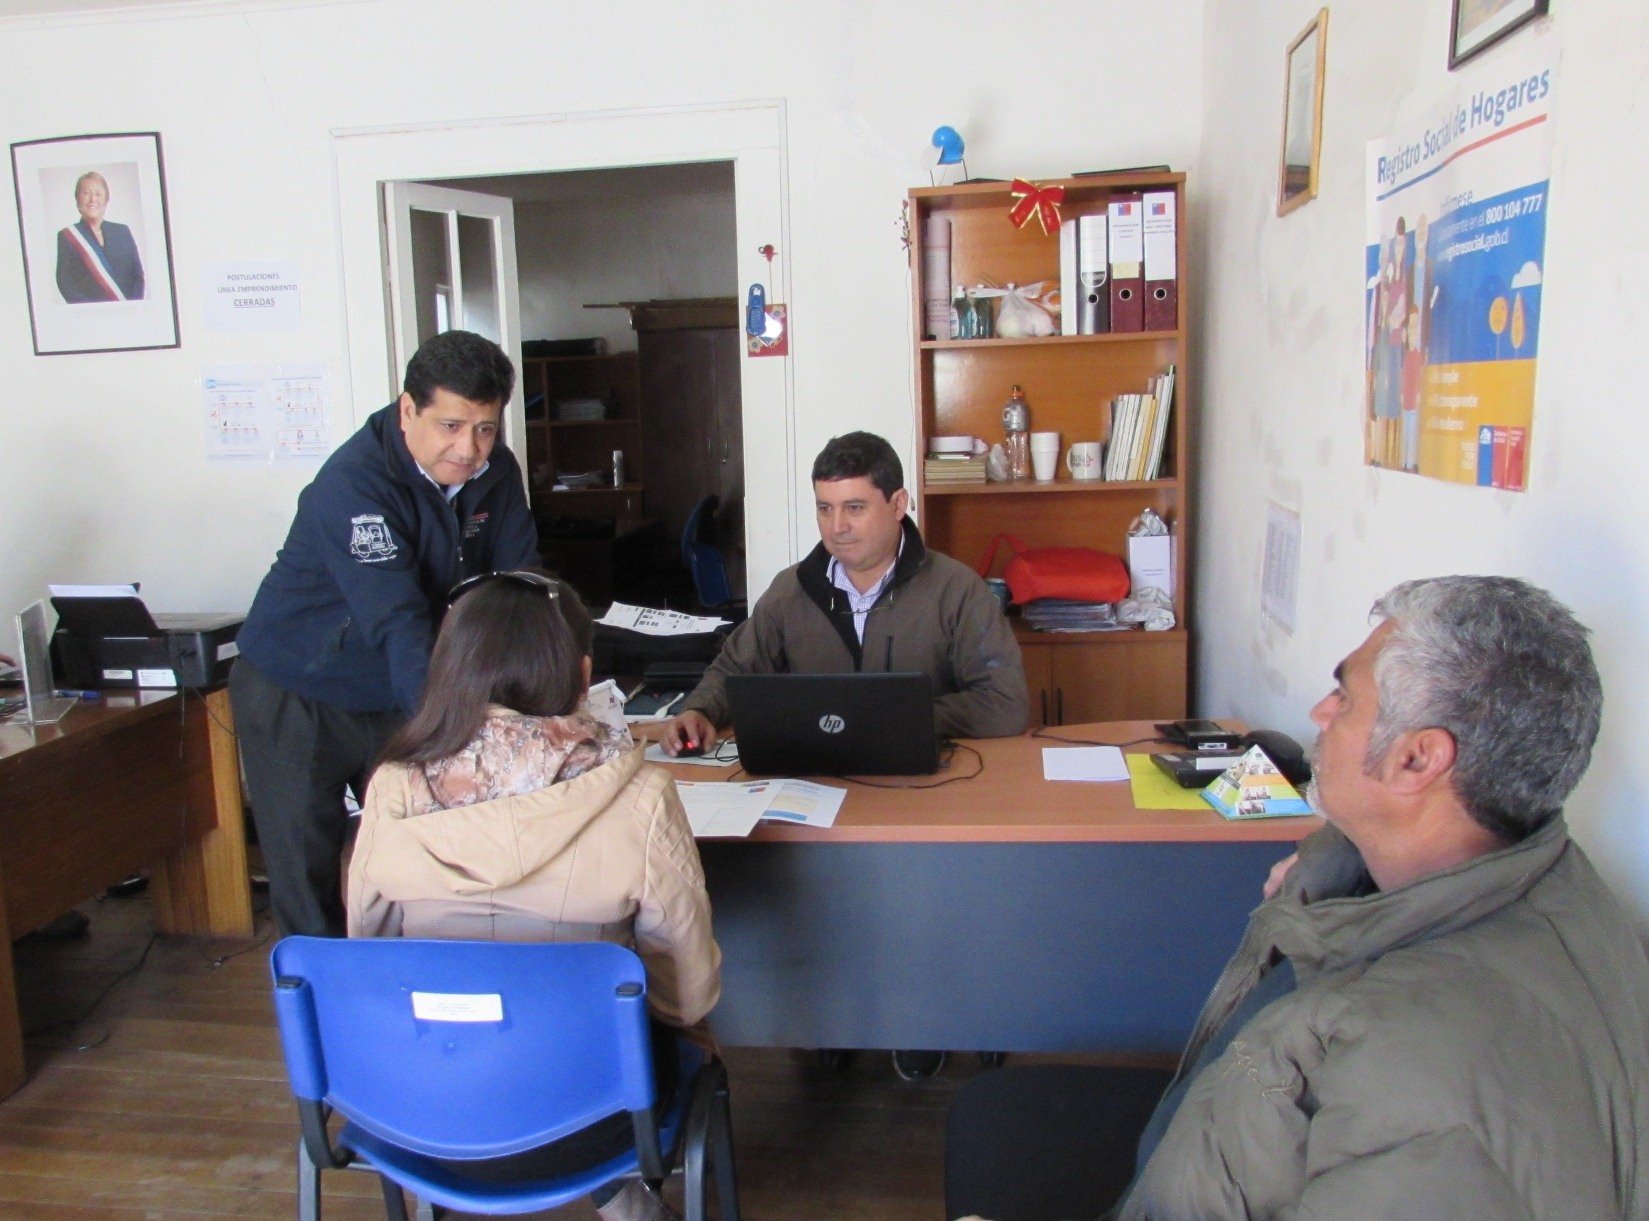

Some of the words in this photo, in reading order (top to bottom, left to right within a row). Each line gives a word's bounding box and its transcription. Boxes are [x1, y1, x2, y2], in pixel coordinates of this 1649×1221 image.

[1377, 143, 1420, 184] Registro
[1423, 112, 1452, 160] Social
[1470, 69, 1549, 129] Hogares
[1485, 205, 1503, 225] 800
[1504, 200, 1520, 220] 104
[1522, 193, 1542, 215] 777
[227, 273, 280, 281] POSTULACIONES
[237, 284, 298, 293] EMPRENDIMIENTO
[233, 298, 276, 307] CERRADAS
[823, 713, 842, 733] hp
